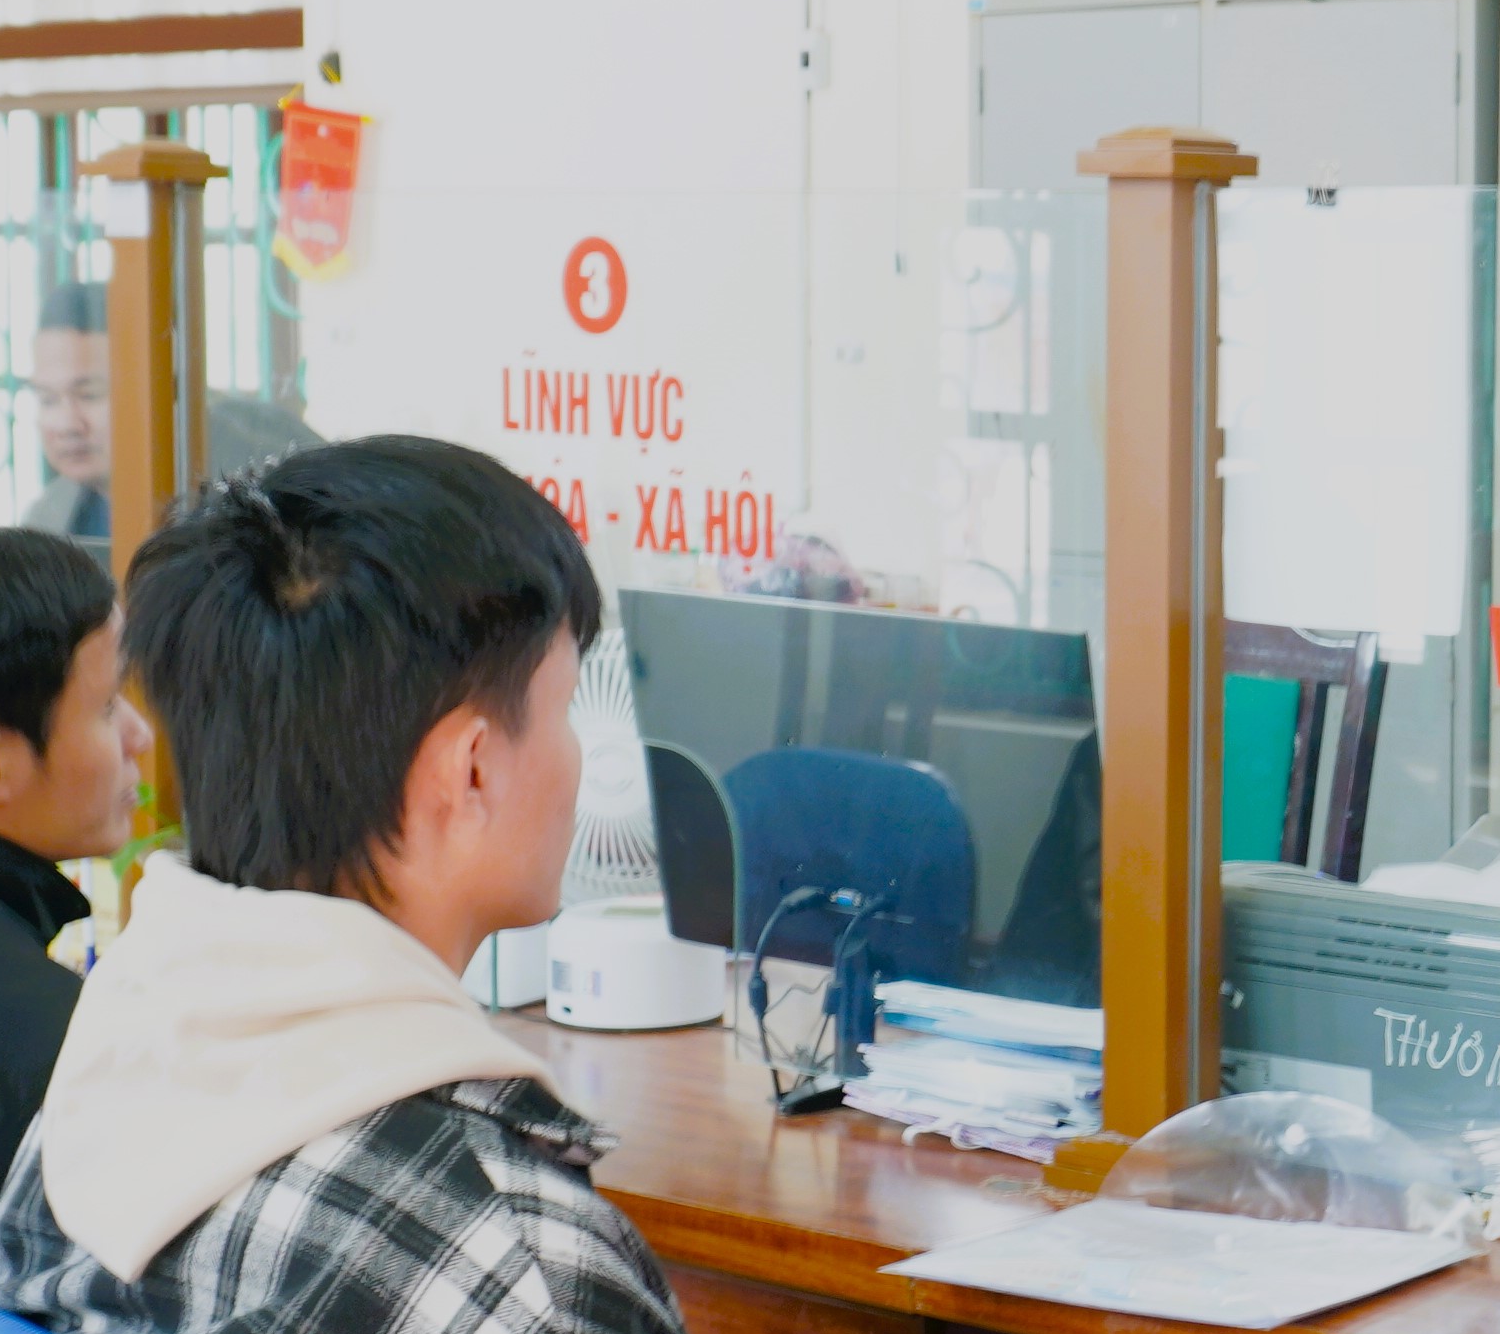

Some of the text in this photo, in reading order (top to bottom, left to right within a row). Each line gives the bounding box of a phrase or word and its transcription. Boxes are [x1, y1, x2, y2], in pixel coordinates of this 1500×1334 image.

[578, 250, 611, 319] 3
[502, 349, 685, 455] LĨNH VỰC
[634, 468, 688, 553] XÃ
[704, 468, 775, 573] HỘI
